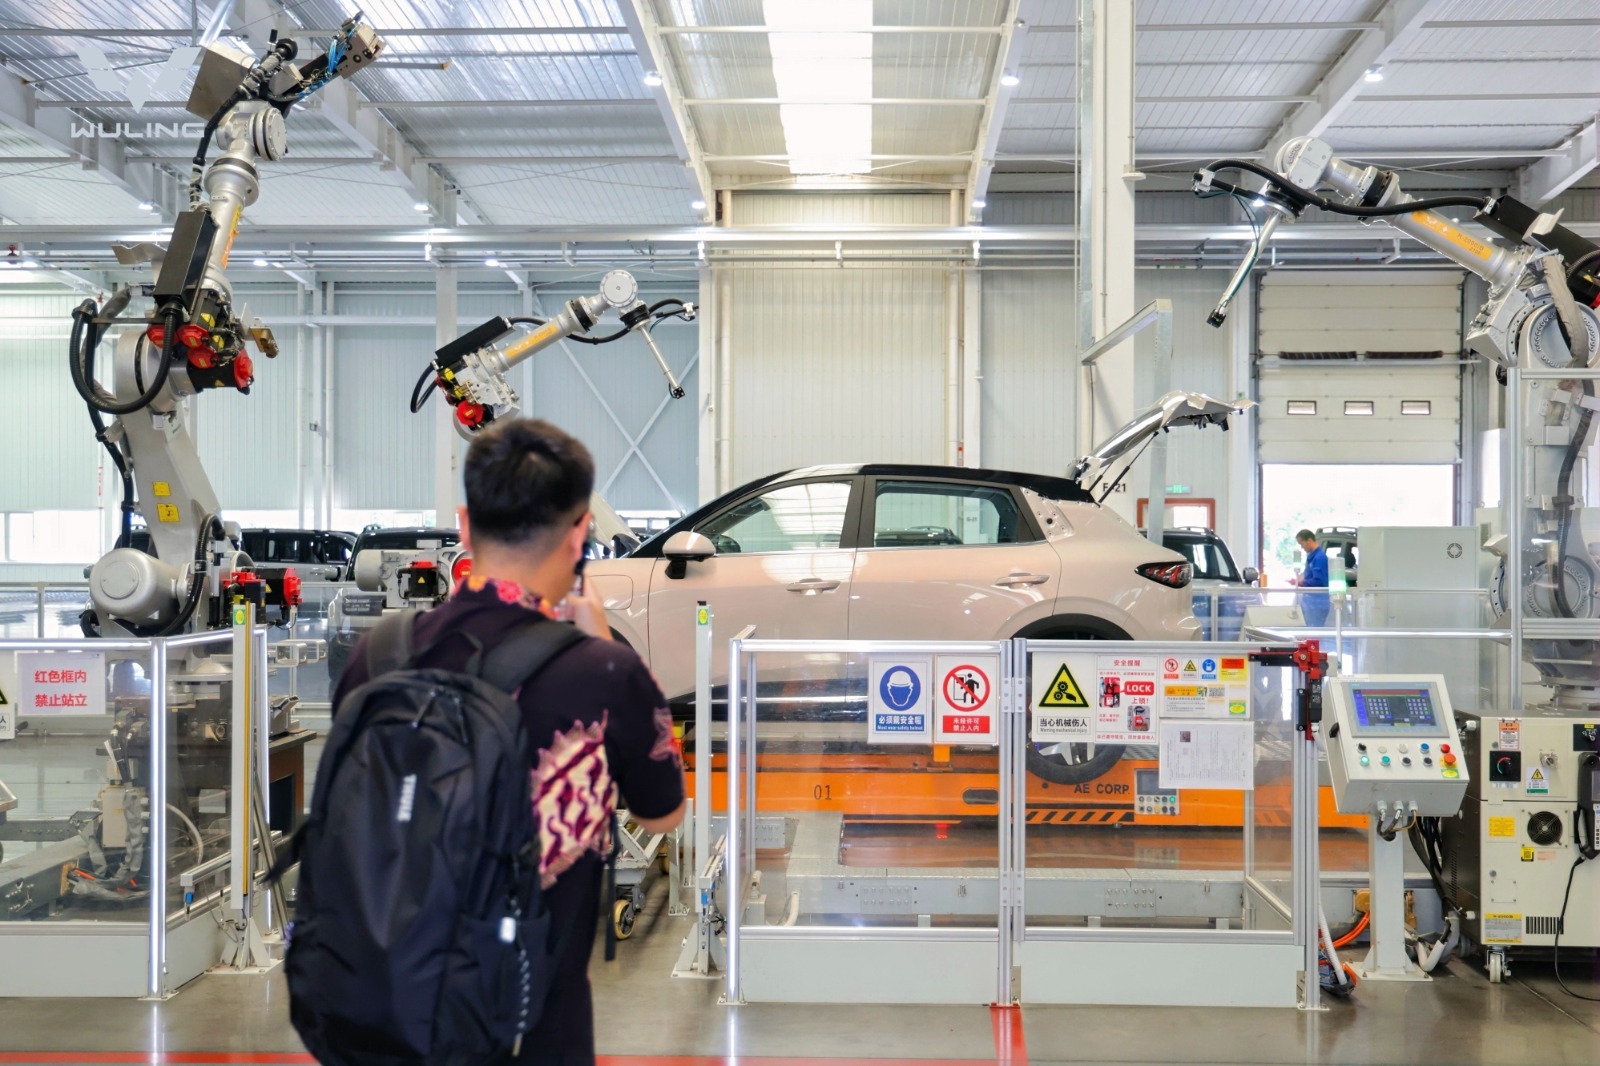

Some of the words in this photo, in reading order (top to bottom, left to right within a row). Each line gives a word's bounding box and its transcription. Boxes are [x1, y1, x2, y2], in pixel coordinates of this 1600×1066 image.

[1113, 659, 1141, 667] 安全提醒
[34, 669, 87, 683] 红色框内
[1126, 684, 1151, 693] LOCK
[35, 693, 88, 707] 禁止站立
[878, 715, 922, 725] 必须戴安全帽
[952, 717, 980, 725] 未经许可
[1039, 718, 1088, 727] 当心机械伤人
[814, 784, 832, 800] 01
[1074, 783, 1090, 794] AE
